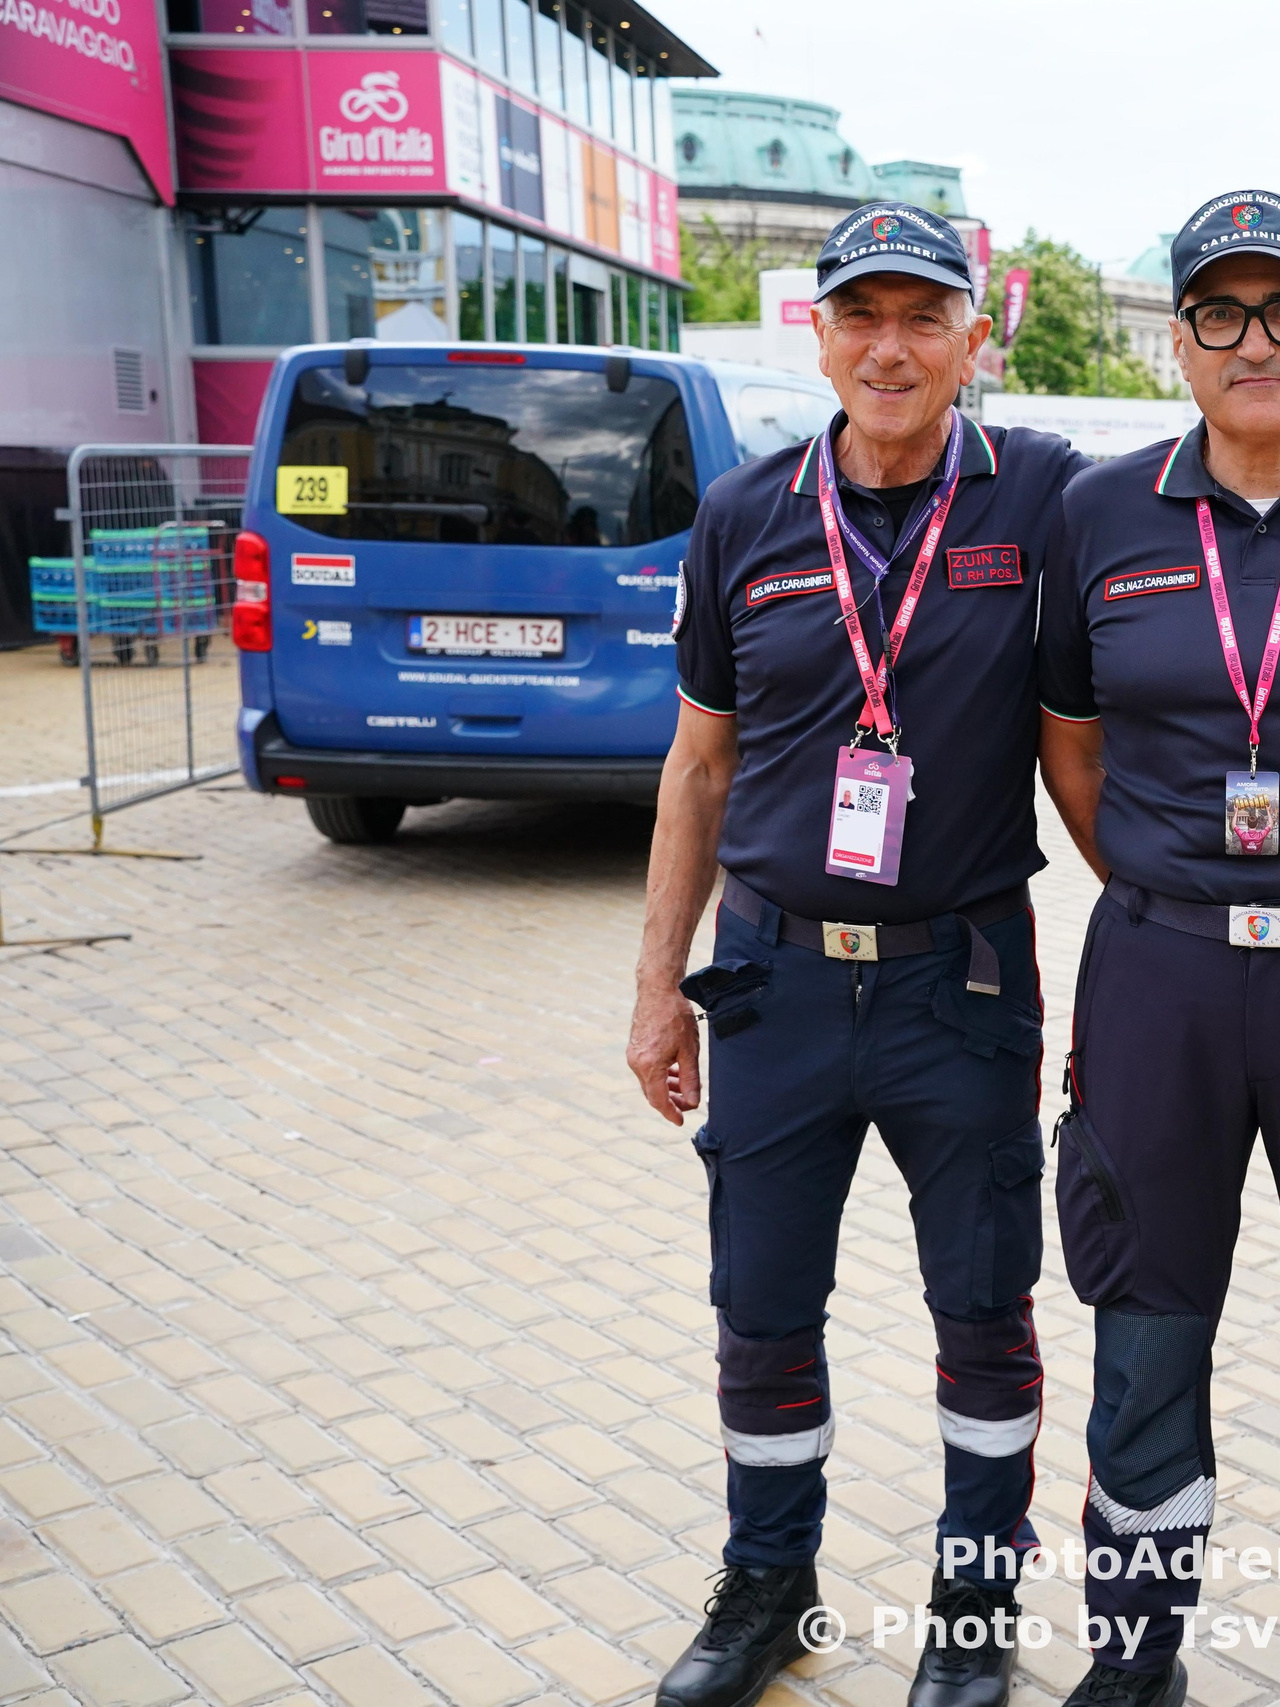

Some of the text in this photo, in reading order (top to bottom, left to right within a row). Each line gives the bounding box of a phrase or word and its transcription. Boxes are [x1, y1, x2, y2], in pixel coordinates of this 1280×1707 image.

[0, 0, 137, 72] ARAVAGGIO
[320, 125, 434, 161] Giro d'Italia
[896, 209, 944, 239] NAZIONALE
[1191, 194, 1253, 232] ASSOCIAZIONE
[840, 243, 937, 263] CARABINIERI
[295, 477, 328, 501] 239
[922, 526, 940, 557] Giro d'Italia
[952, 551, 1016, 568] ZUIN C.
[967, 569, 985, 582] RH
[989, 568, 1016, 579] POS.
[1207, 547, 1221, 578] Giro d'Italia
[910, 561, 928, 592] Giro d'Italia
[896, 596, 916, 627] Giro d'Italia
[1220, 617, 1235, 649] Giro d'Italia
